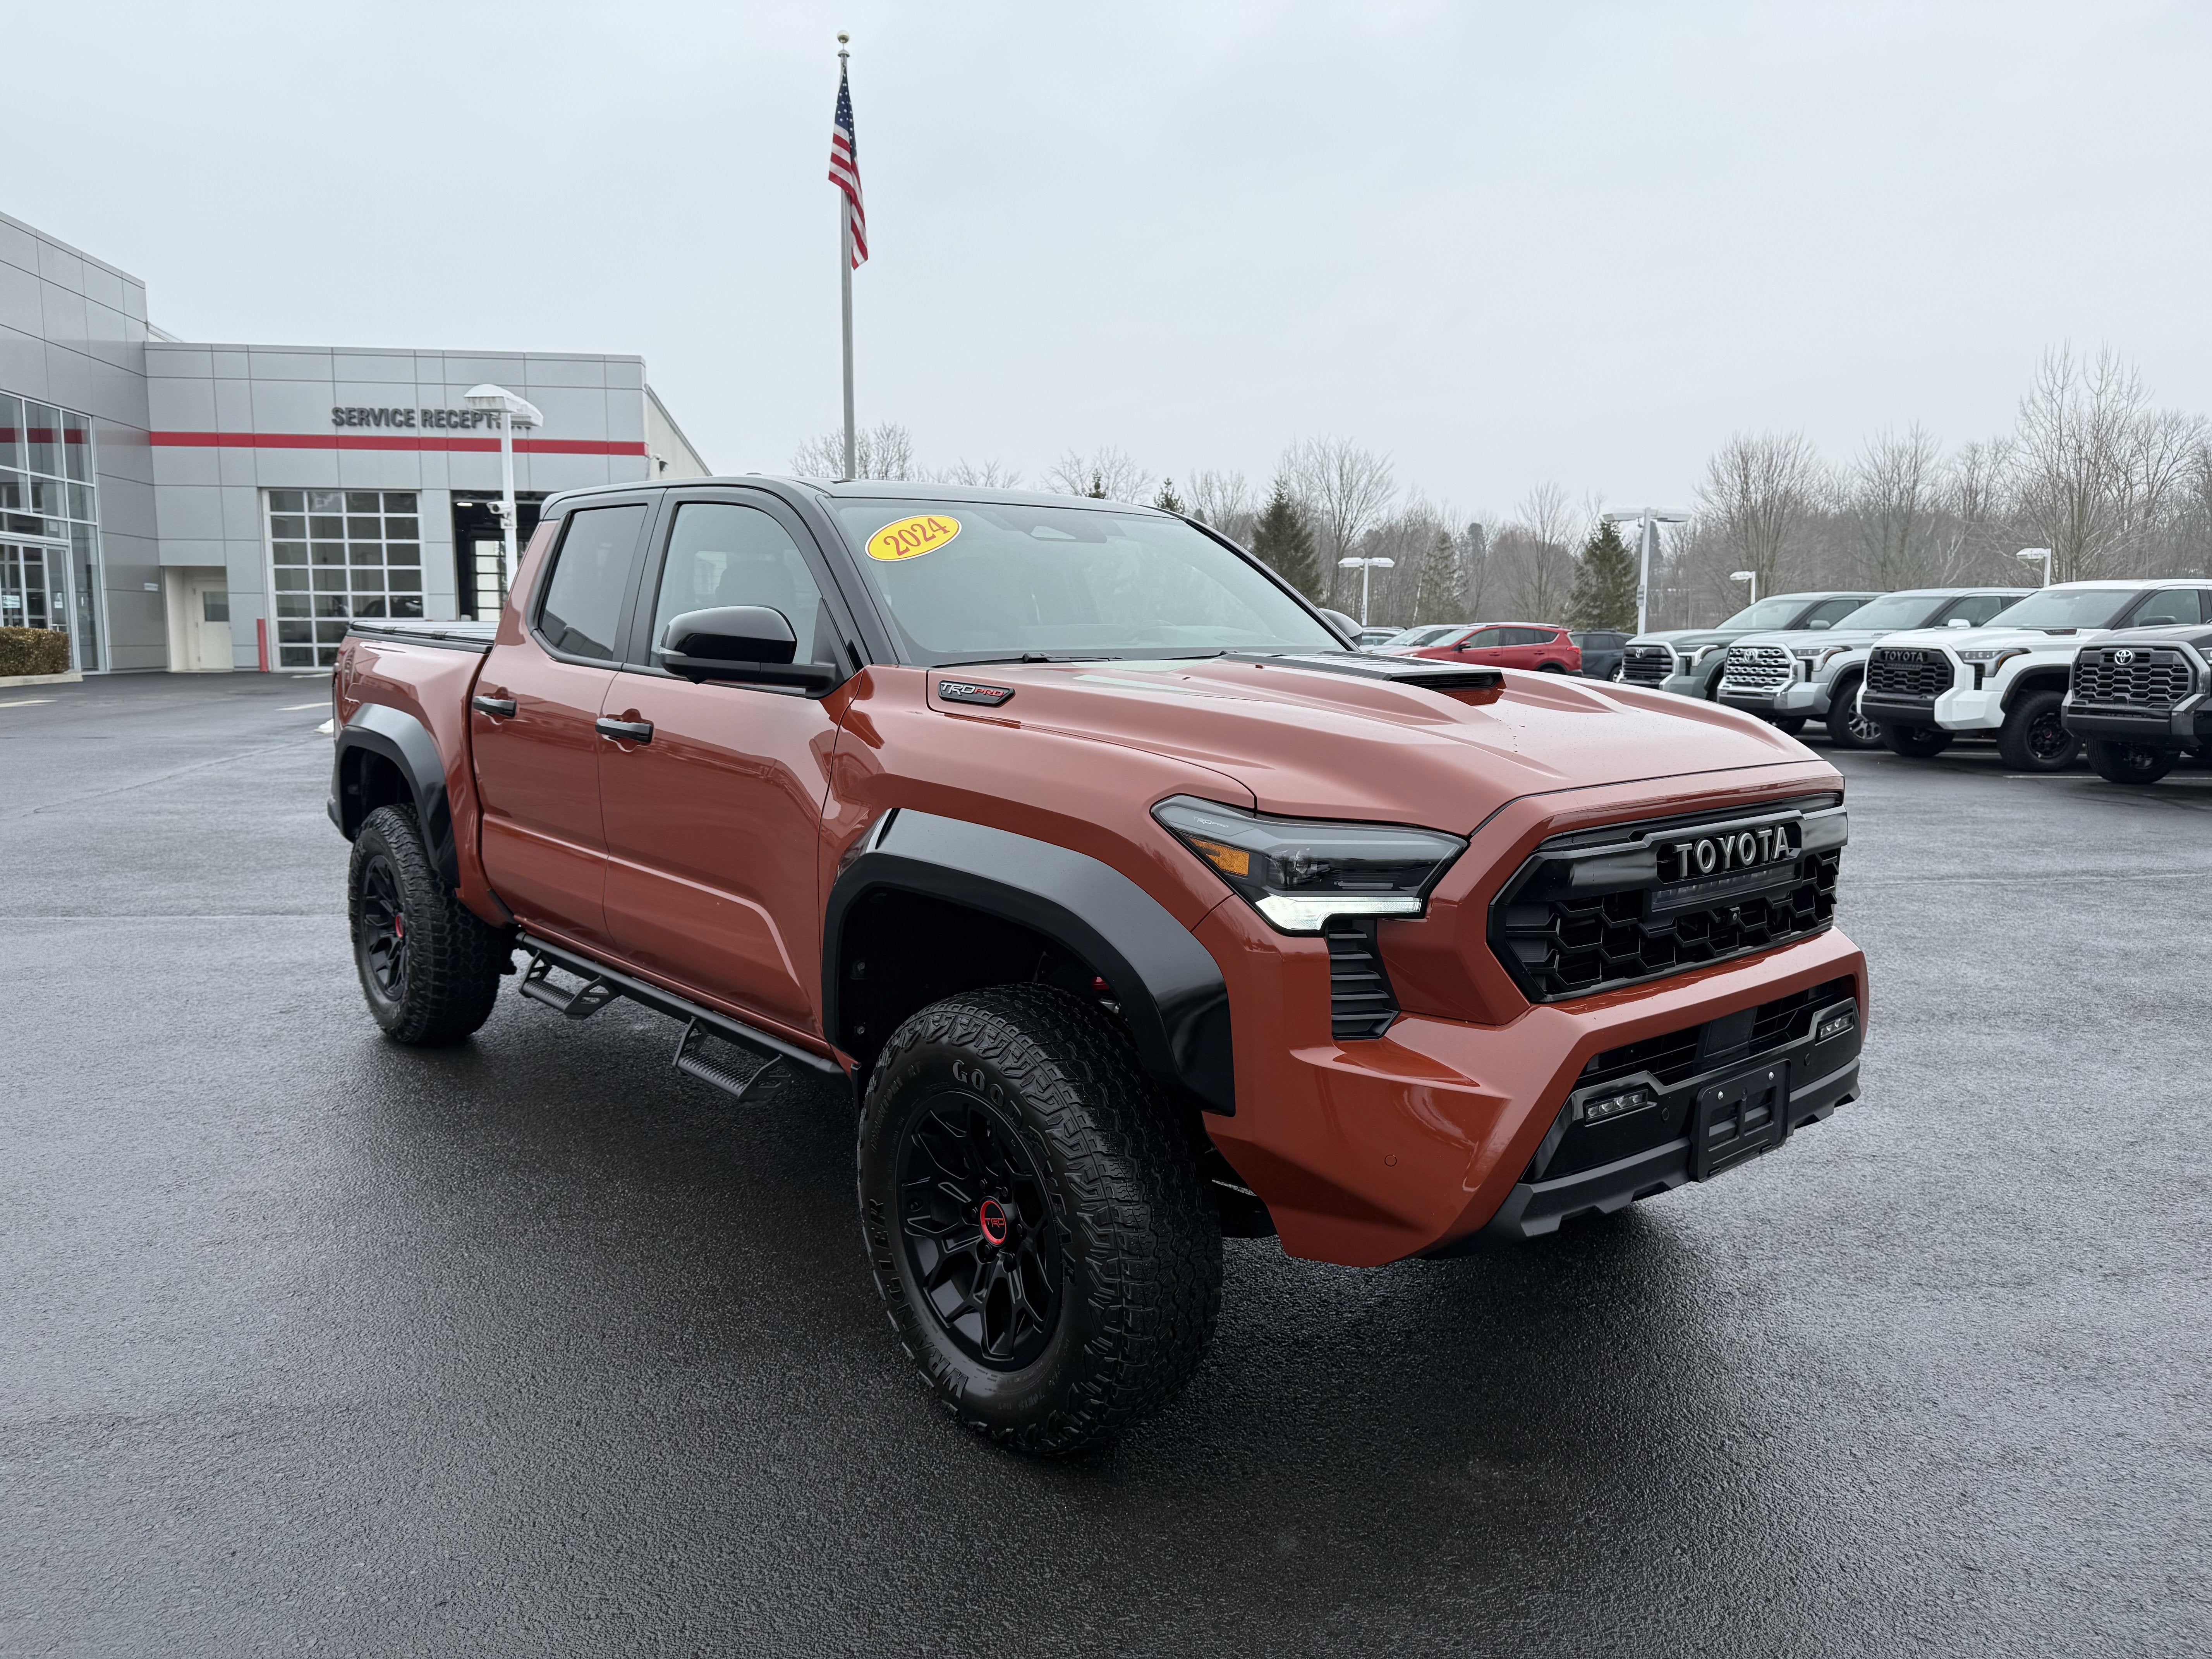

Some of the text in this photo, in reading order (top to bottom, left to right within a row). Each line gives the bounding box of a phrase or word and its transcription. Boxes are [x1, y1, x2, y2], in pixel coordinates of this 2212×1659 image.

[331, 407, 531, 429] SERVICE RECEPT
[883, 518, 950, 556] 2024
[1884, 651, 1923, 662] TOYOTA
[1674, 826, 1790, 879] TOYOTA
[984, 1218, 1005, 1228] TRD
[869, 1198, 969, 1400] WRANGLER
